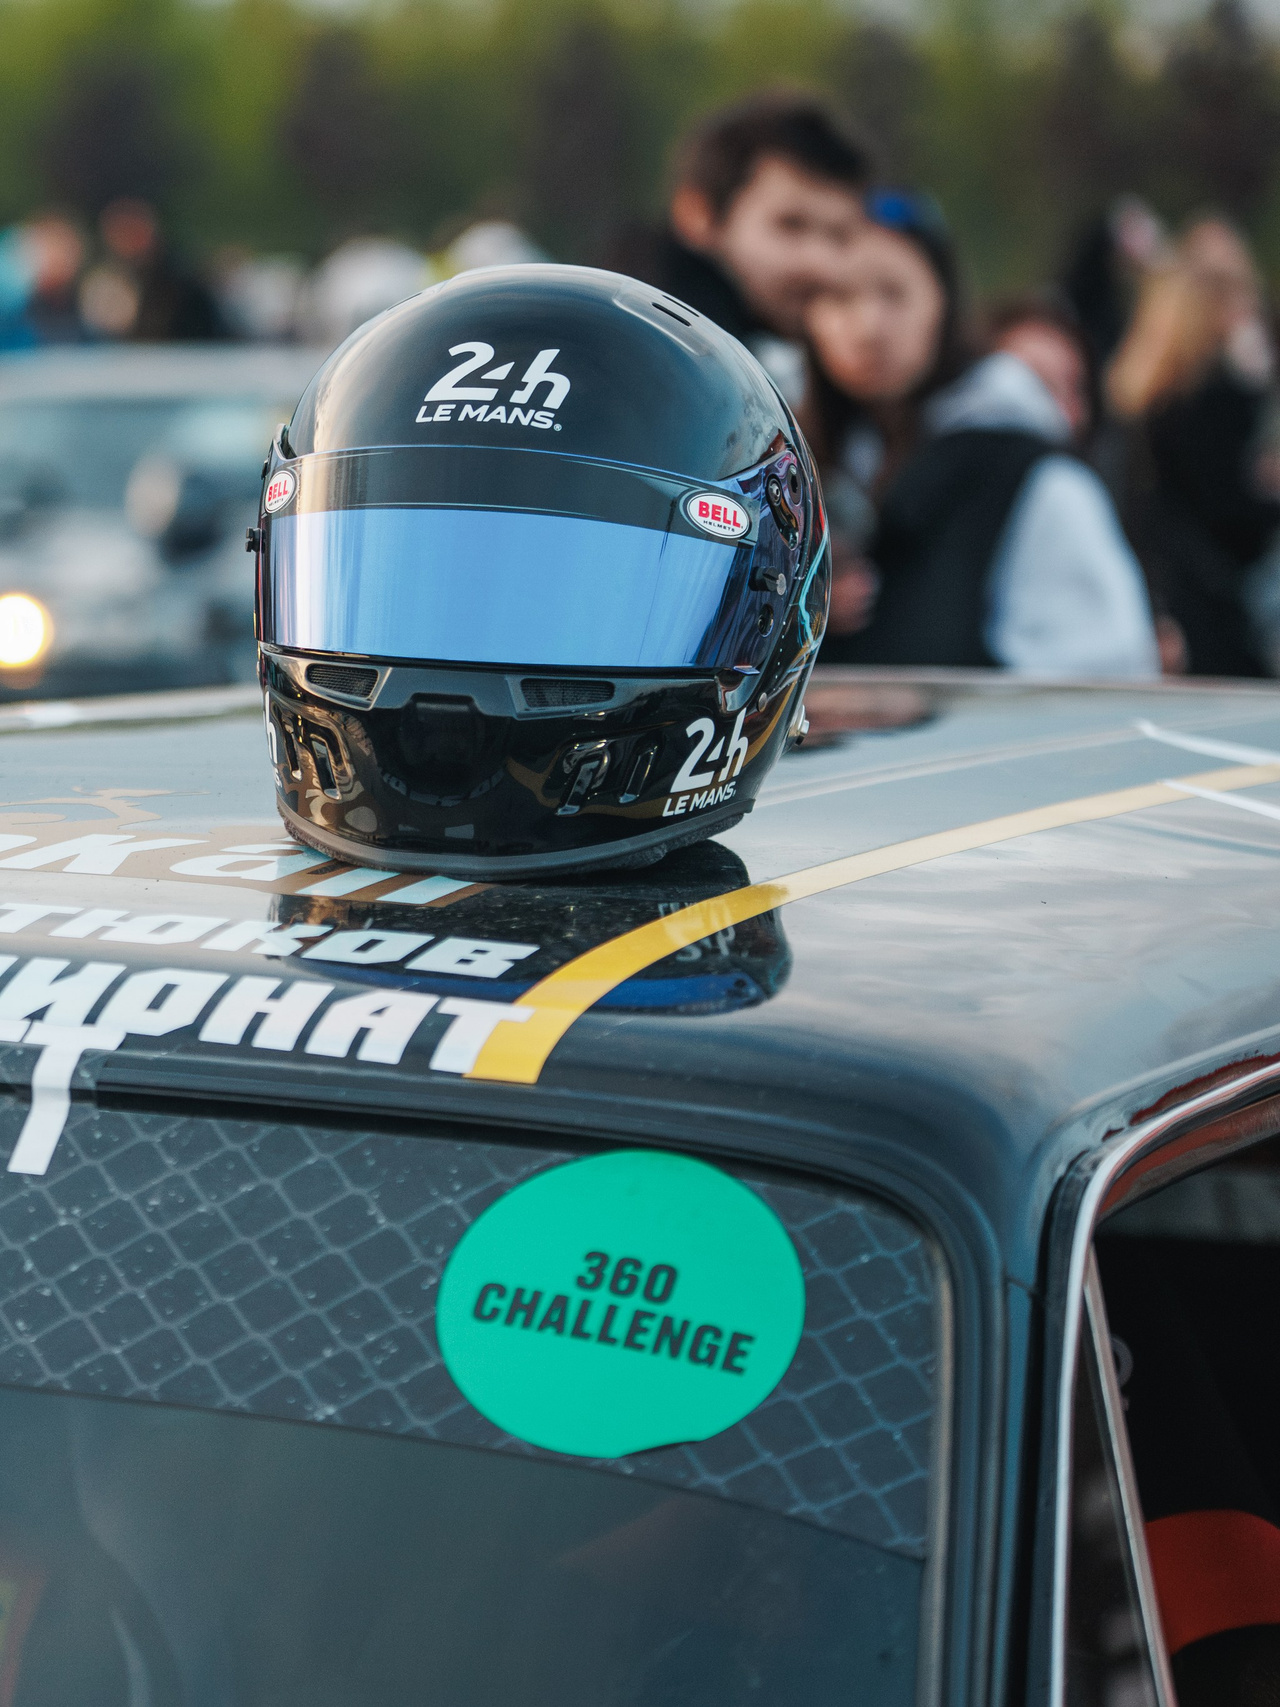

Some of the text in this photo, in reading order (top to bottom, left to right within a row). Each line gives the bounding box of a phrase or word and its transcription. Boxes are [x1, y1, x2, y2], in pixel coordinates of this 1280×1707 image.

[424, 341, 571, 410] 24h
[415, 404, 457, 423] LE
[268, 479, 289, 502] BELL
[698, 500, 741, 528] BELL
[703, 520, 735, 533] HELMETS
[670, 707, 749, 793] 24h
[662, 795, 691, 817] LE
[575, 1250, 678, 1304] 360
[472, 1282, 756, 1376] CHALLENGE
